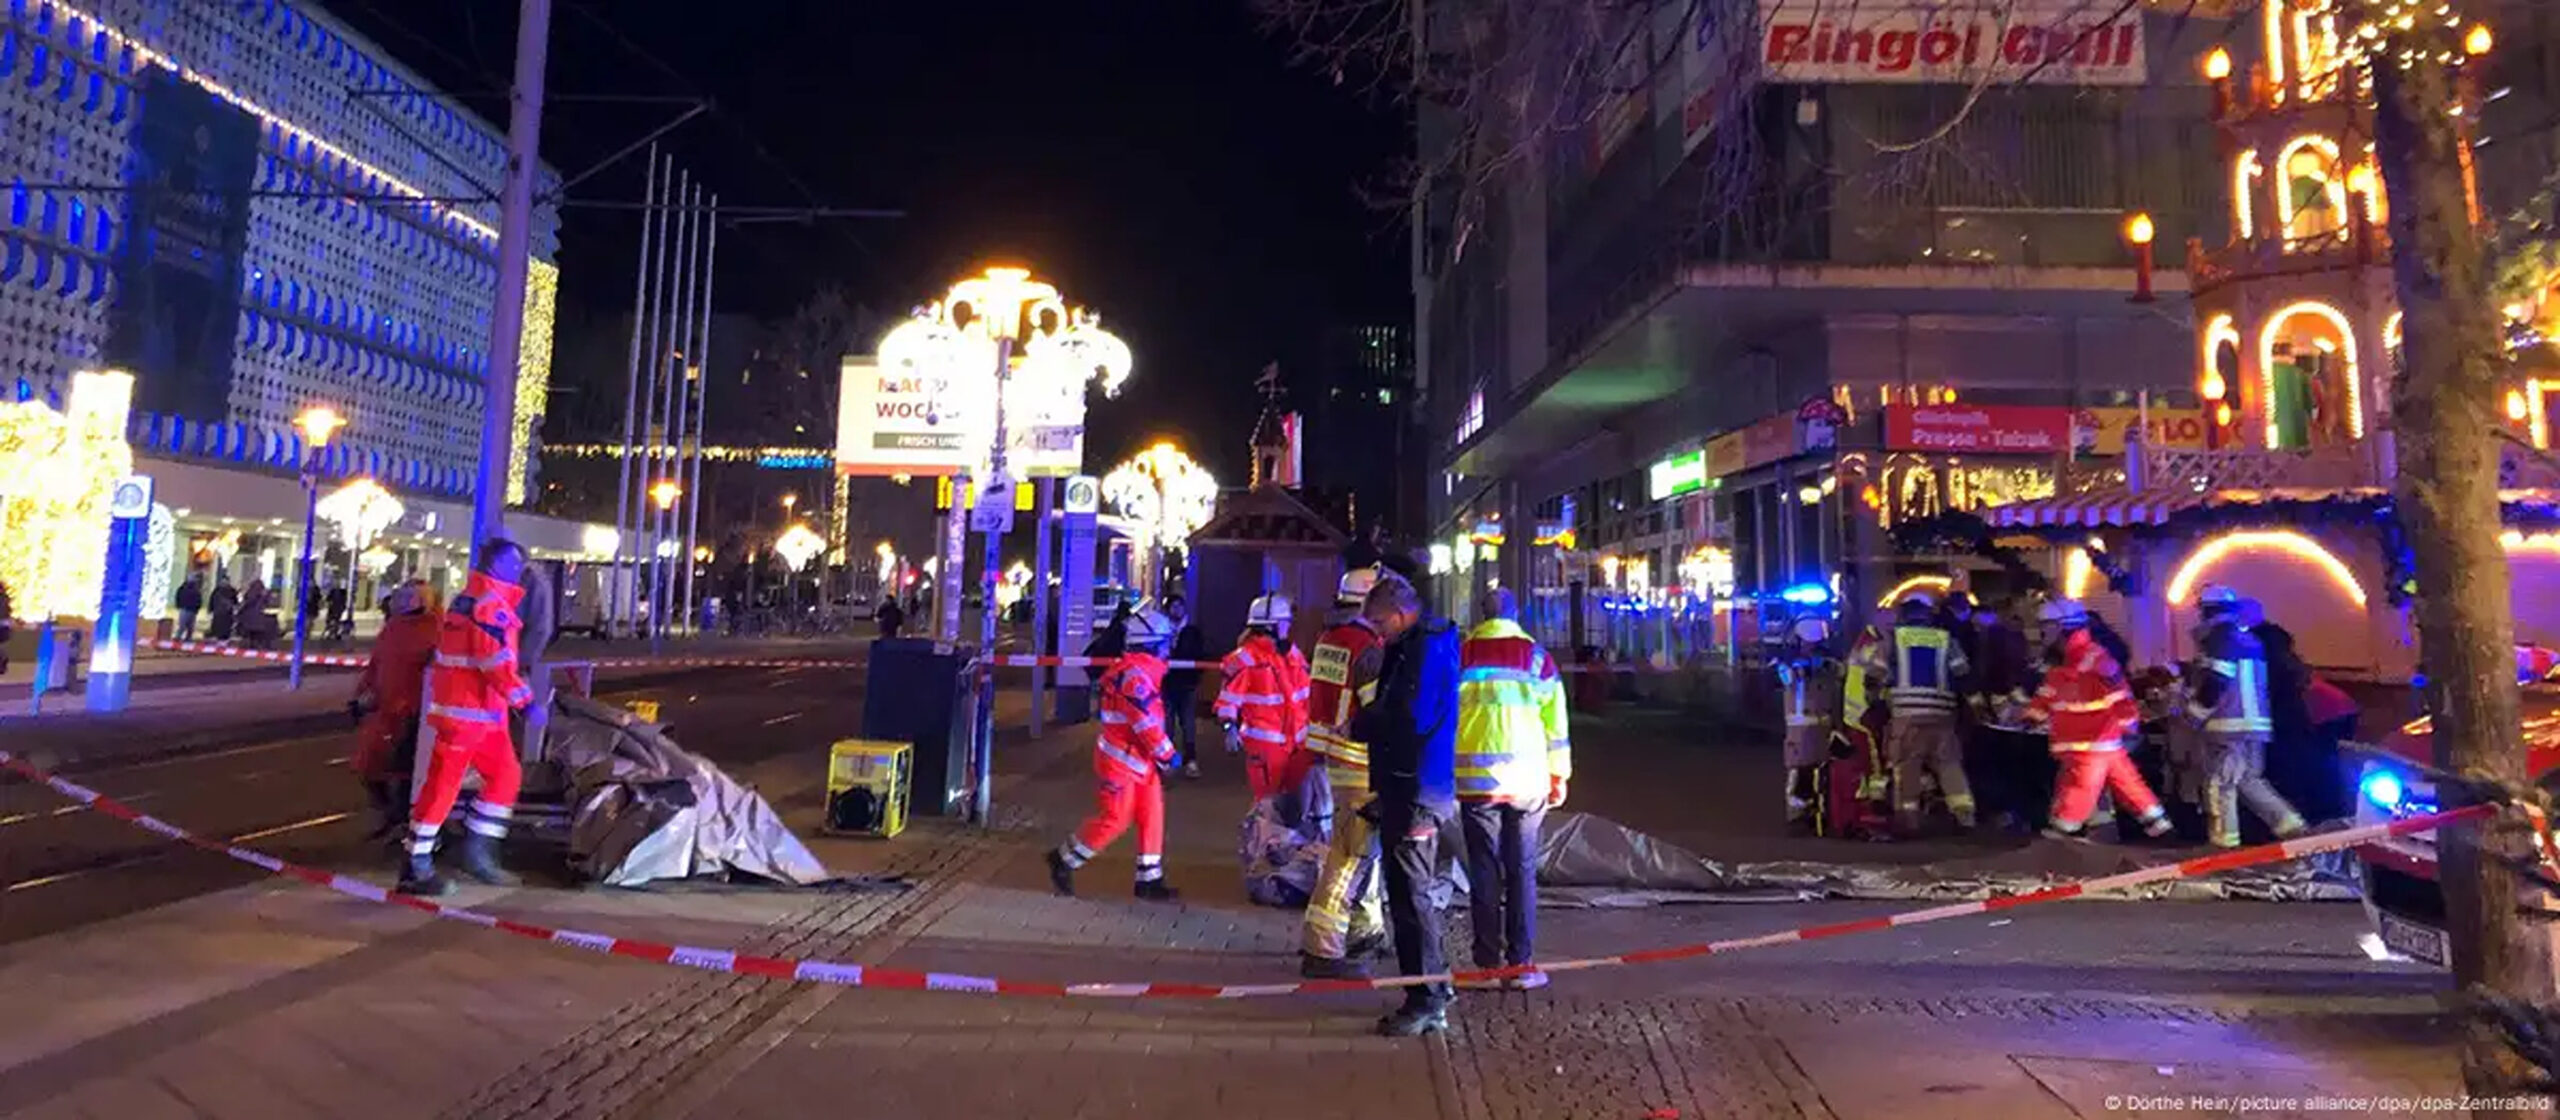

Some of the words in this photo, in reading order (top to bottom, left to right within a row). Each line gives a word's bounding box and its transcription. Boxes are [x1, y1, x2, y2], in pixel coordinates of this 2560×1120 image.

[1766, 21, 1981, 74] Bingöl
[2003, 23, 2135, 67] Grill
[897, 434, 937, 448] FRISCH
[1911, 428, 1977, 447] Presse
